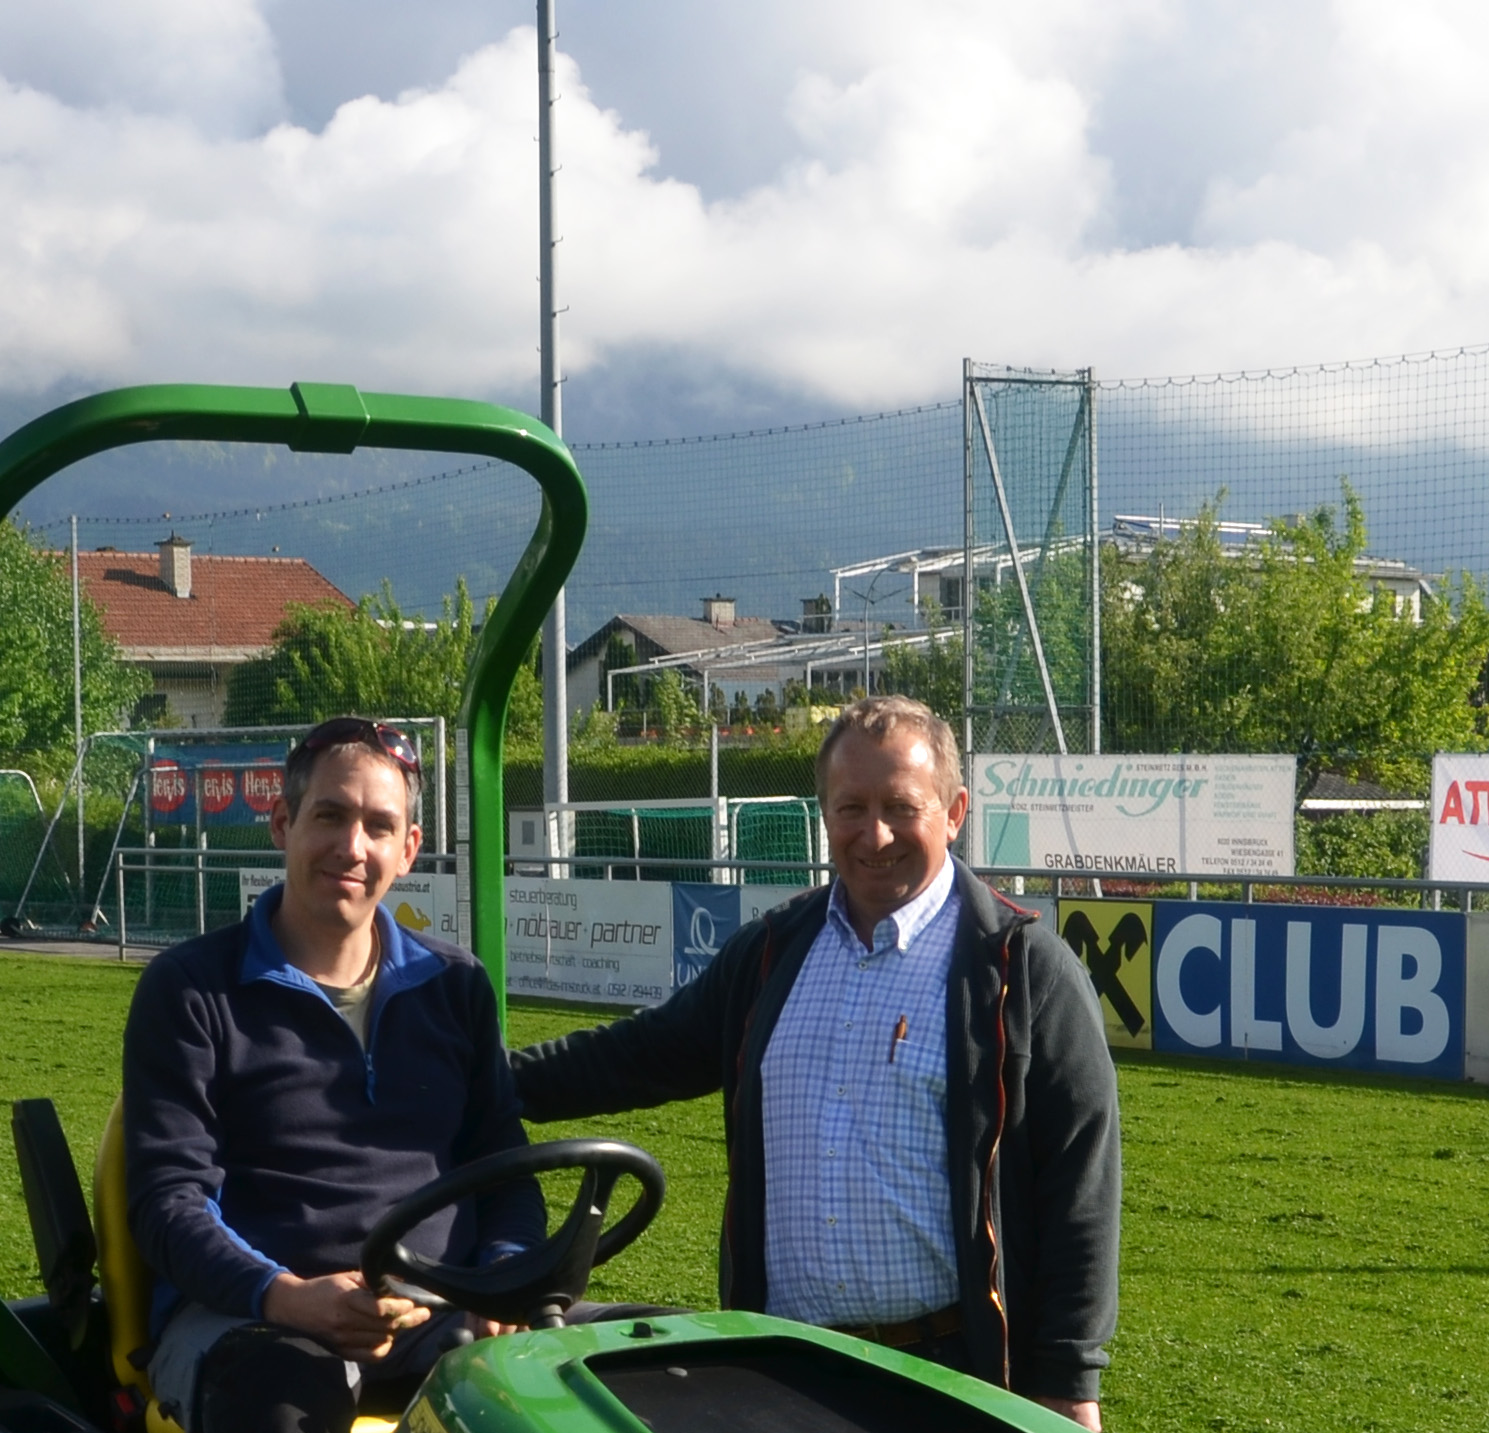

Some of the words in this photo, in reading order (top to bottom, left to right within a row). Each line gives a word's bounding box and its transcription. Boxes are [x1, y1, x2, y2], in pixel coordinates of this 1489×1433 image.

[204, 773, 234, 802] ervis
[245, 770, 282, 801] Hervis
[978, 760, 1208, 817] Schmiedinger
[1044, 852, 1177, 874] GRABDENKMÄLER
[1201, 857, 1229, 866] TELEFON
[510, 888, 577, 911] steuerberatung
[516, 912, 582, 941] nöbauer
[591, 920, 661, 948] partner
[582, 957, 620, 973] coaching
[608, 982, 626, 997] 0512
[1157, 913, 1450, 1063] CLUB
